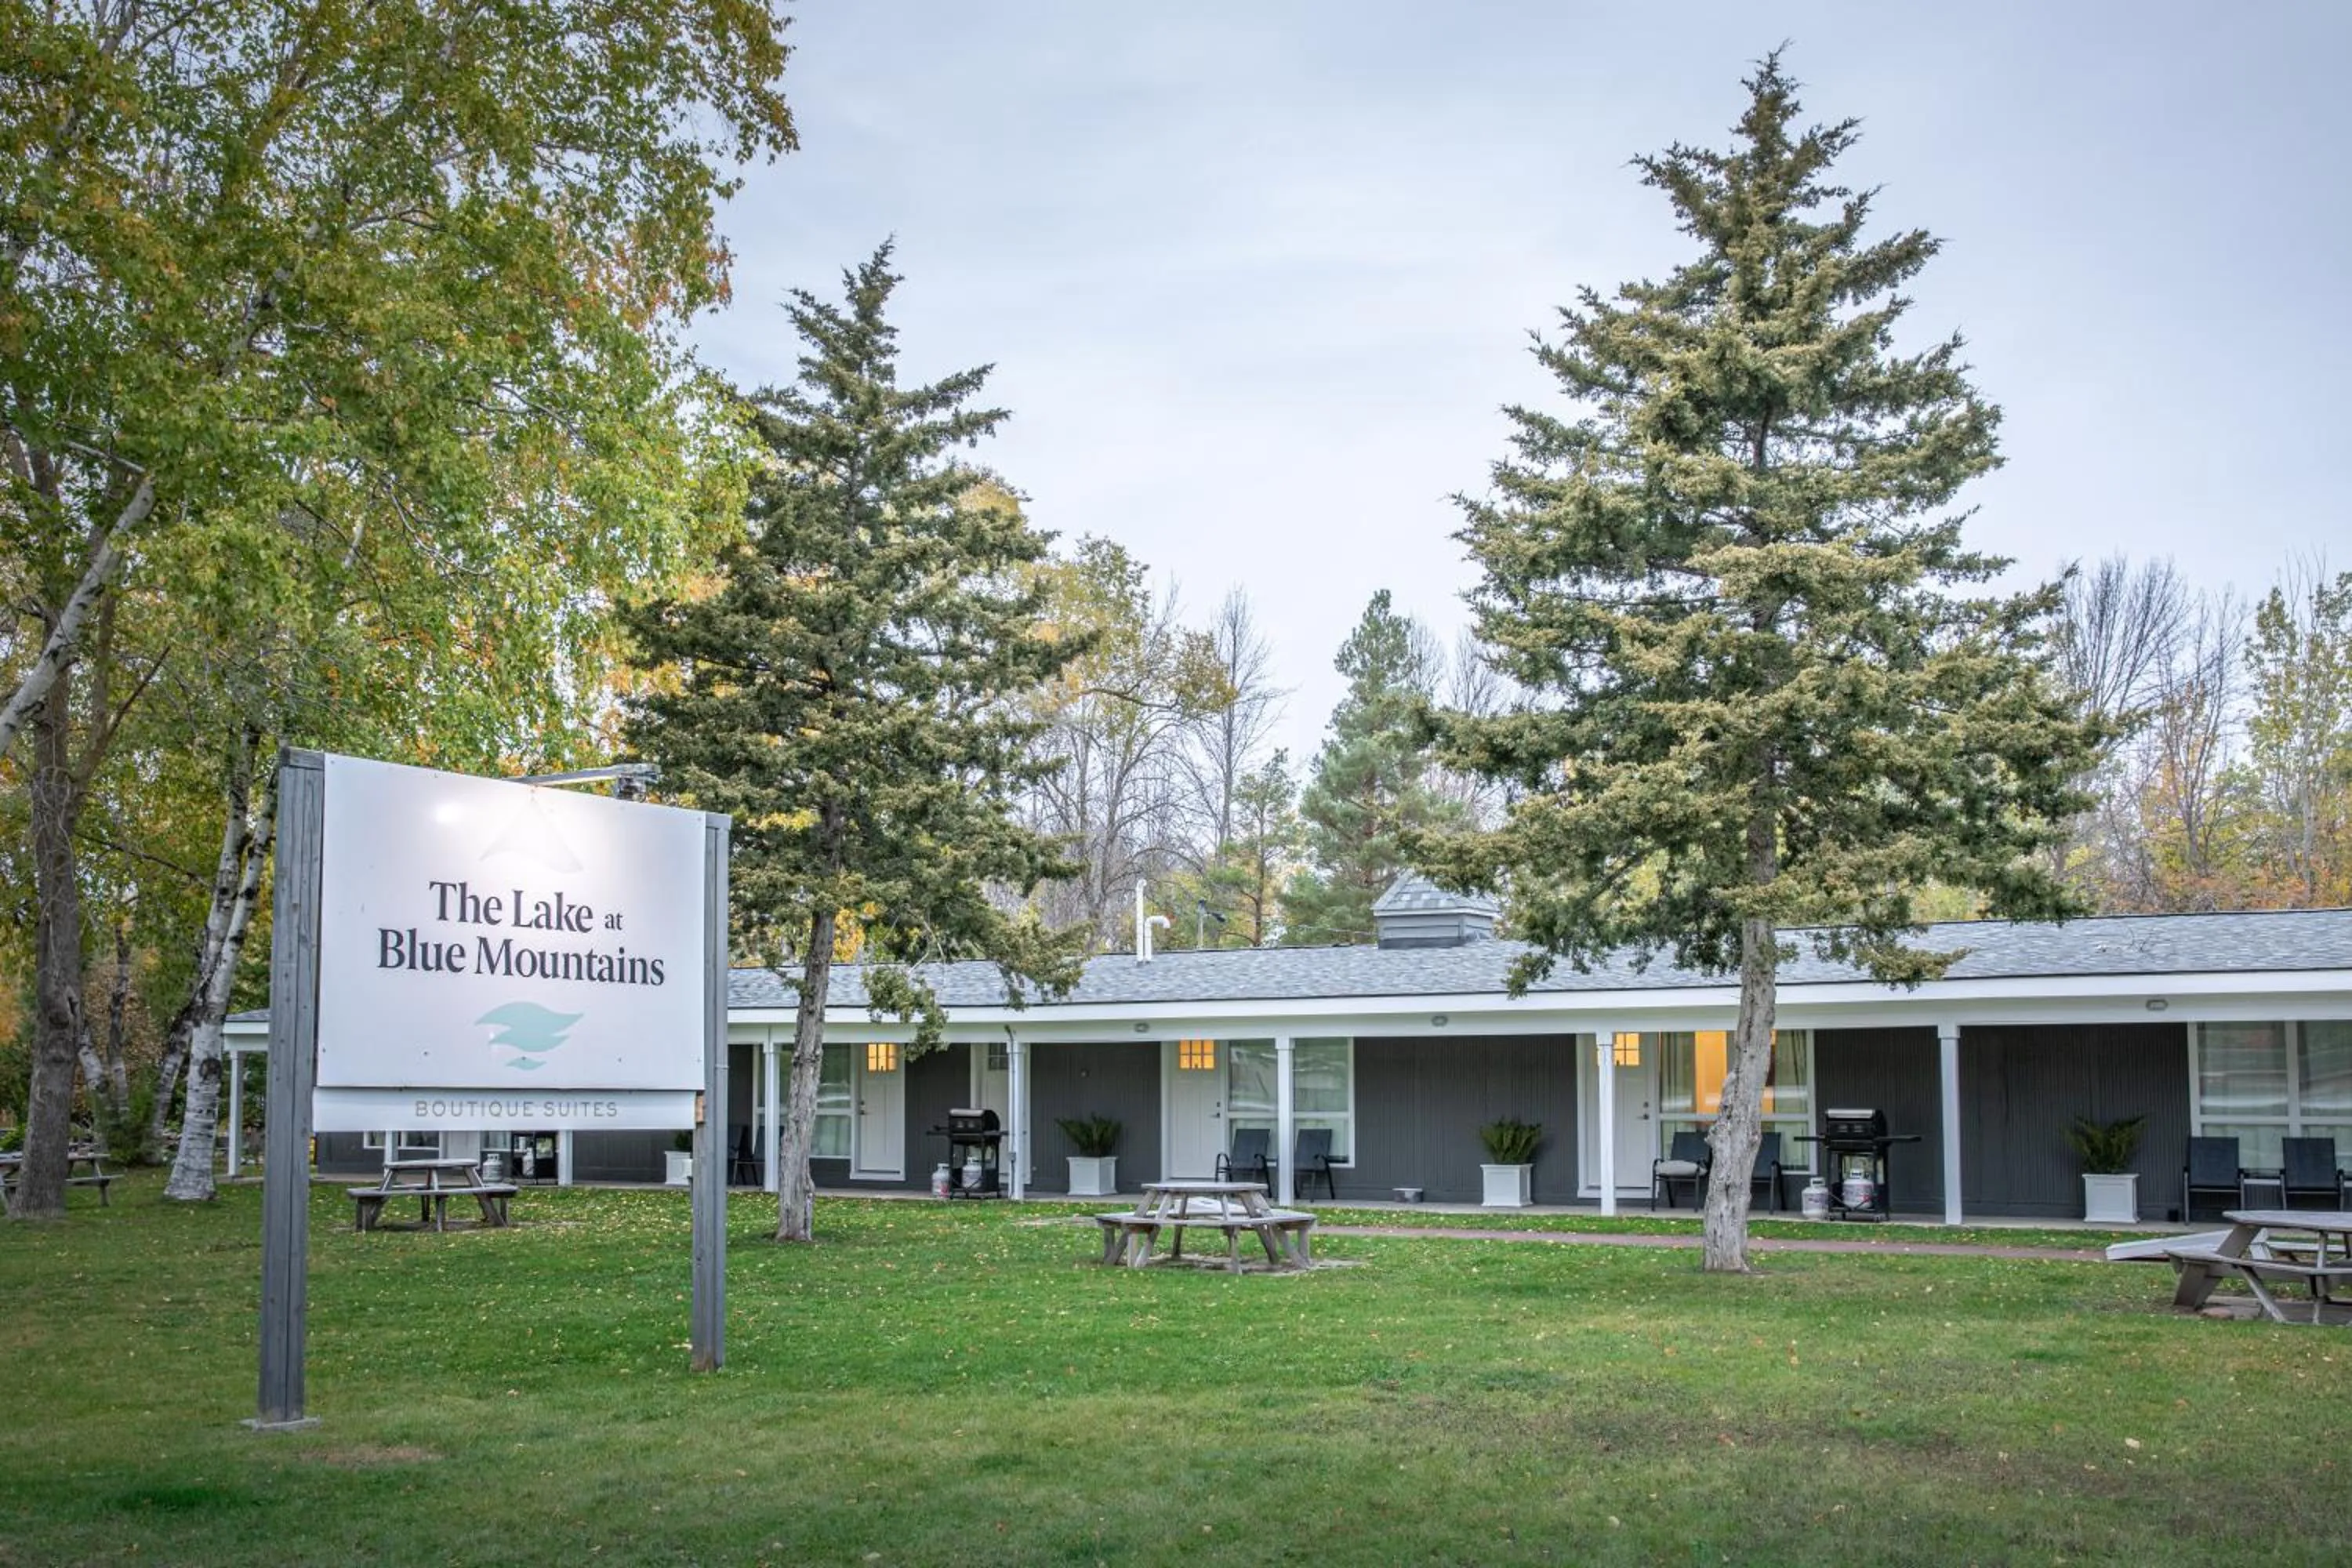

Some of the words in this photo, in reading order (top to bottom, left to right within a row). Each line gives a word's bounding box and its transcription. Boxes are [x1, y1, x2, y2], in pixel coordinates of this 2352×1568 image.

[429, 880, 503, 926] The
[512, 890, 593, 933] Lake
[604, 911, 623, 931] at
[377, 927, 466, 974] Blue
[474, 935, 666, 986] Mountains
[415, 1100, 535, 1118] BOUTIQUE
[543, 1101, 619, 1117] SUITES
